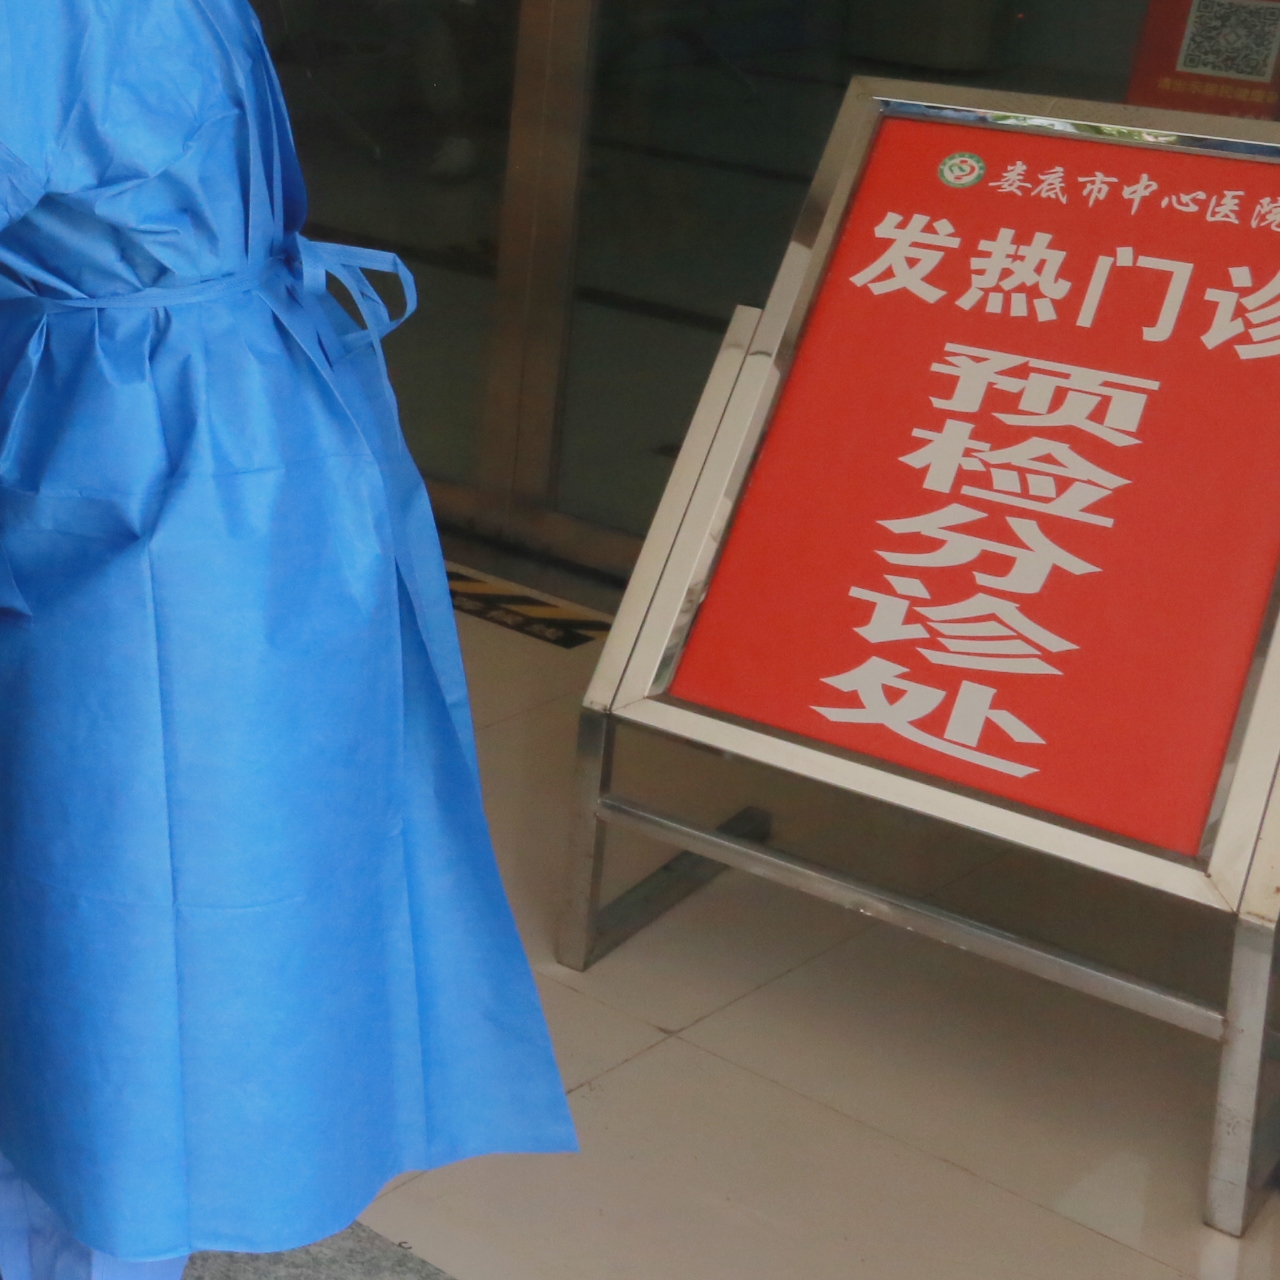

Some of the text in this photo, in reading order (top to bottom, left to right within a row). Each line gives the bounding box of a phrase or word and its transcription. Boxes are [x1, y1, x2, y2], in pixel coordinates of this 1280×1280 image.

[988, 161, 1280, 231] 娄底市中心医院
[849, 210, 1280, 360] 发热门诊
[809, 342, 1160, 778] 预检分诊处
